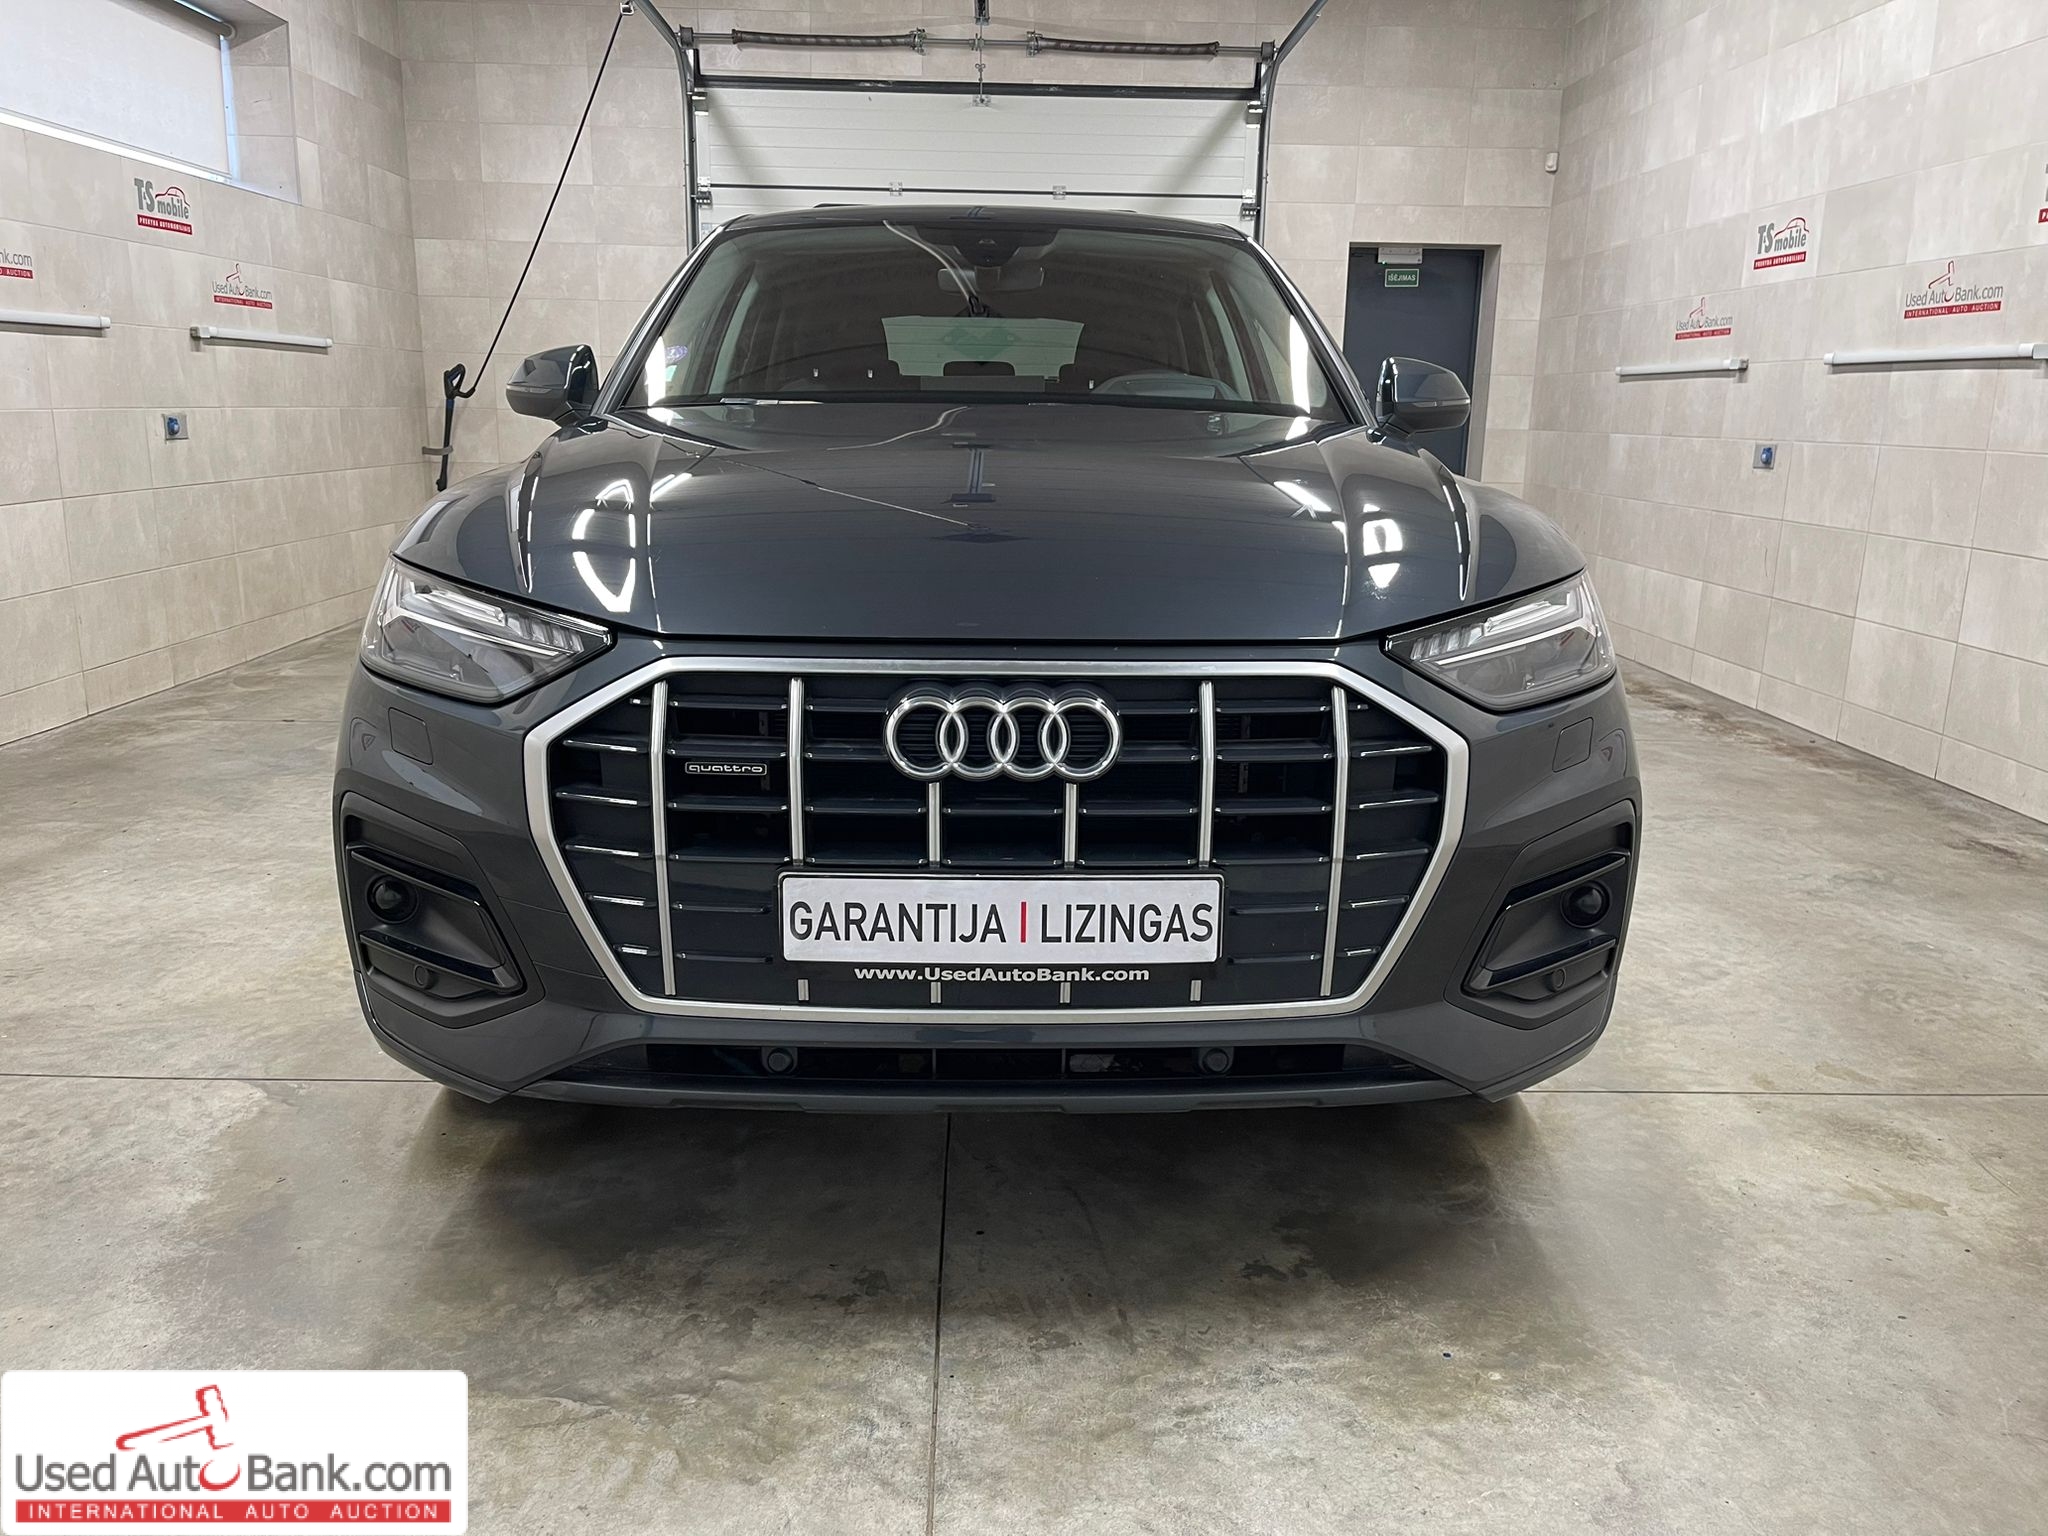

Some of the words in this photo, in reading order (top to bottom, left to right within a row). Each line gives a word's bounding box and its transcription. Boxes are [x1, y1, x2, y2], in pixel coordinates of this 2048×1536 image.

[157, 197, 189, 219] mobile
[1774, 228, 1807, 252] mobile
[1905, 289, 1928, 308] Used
[1906, 307, 1948, 317] INTERNATIONAL
[1971, 303, 1999, 311] AUCTION
[688, 764, 763, 773] quattro
[789, 901, 1007, 943] GARANTIJA
[1040, 902, 1213, 944] LIZINGAS
[853, 967, 1150, 982] www.UsedAutoBank.com
